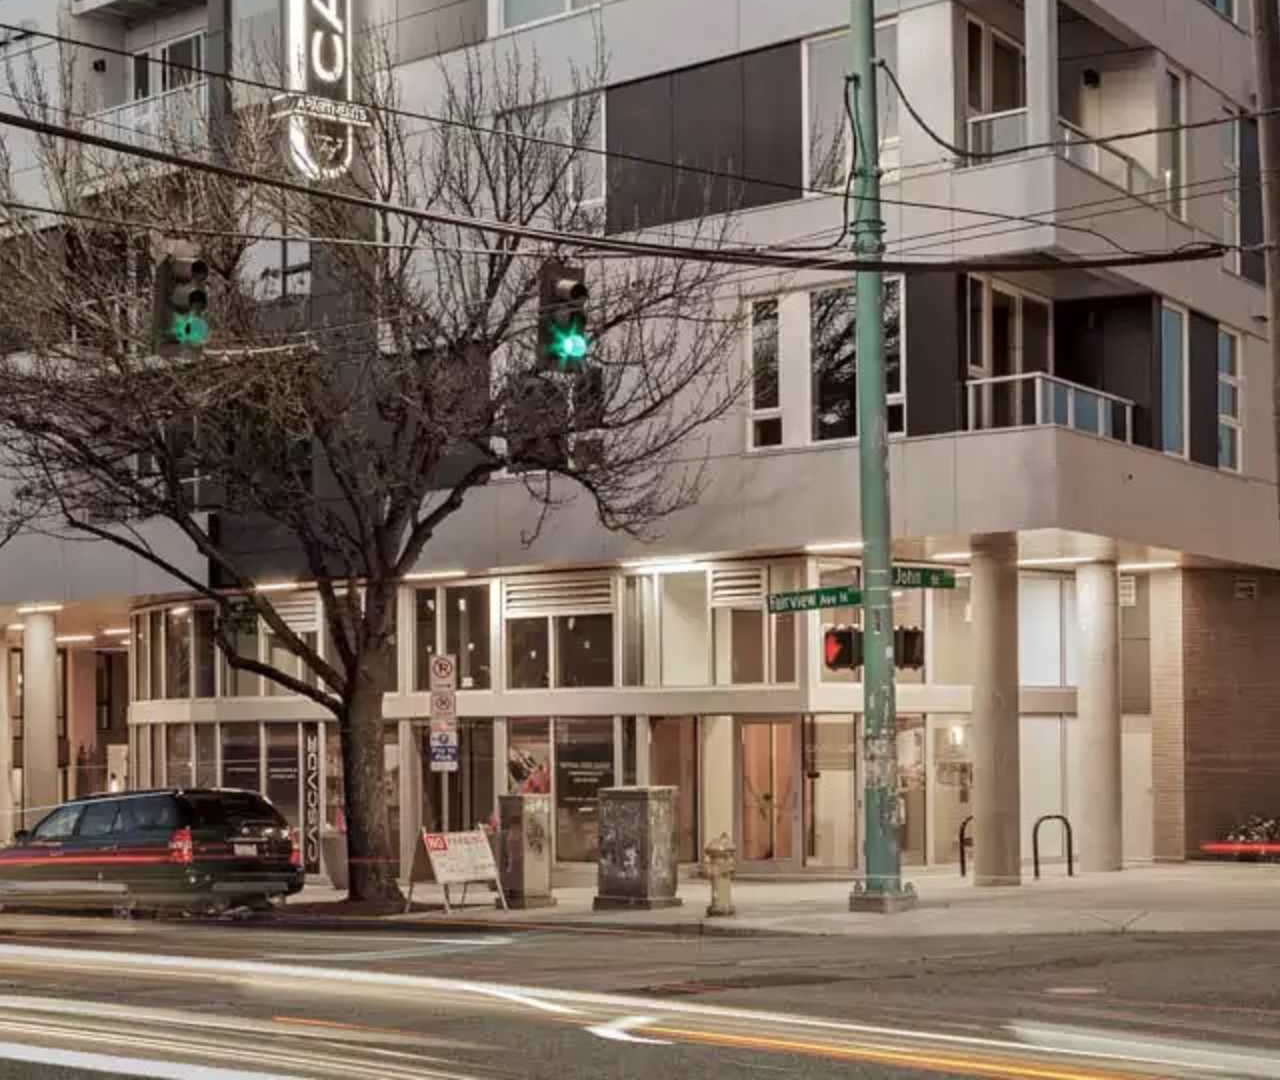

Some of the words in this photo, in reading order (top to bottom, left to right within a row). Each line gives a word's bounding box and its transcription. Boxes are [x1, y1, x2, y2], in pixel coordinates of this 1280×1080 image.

[895, 567, 921, 585] John
[769, 591, 817, 612] Fairview
[820, 594, 837, 607] Ave
[307, 735, 319, 863] CASCADE
